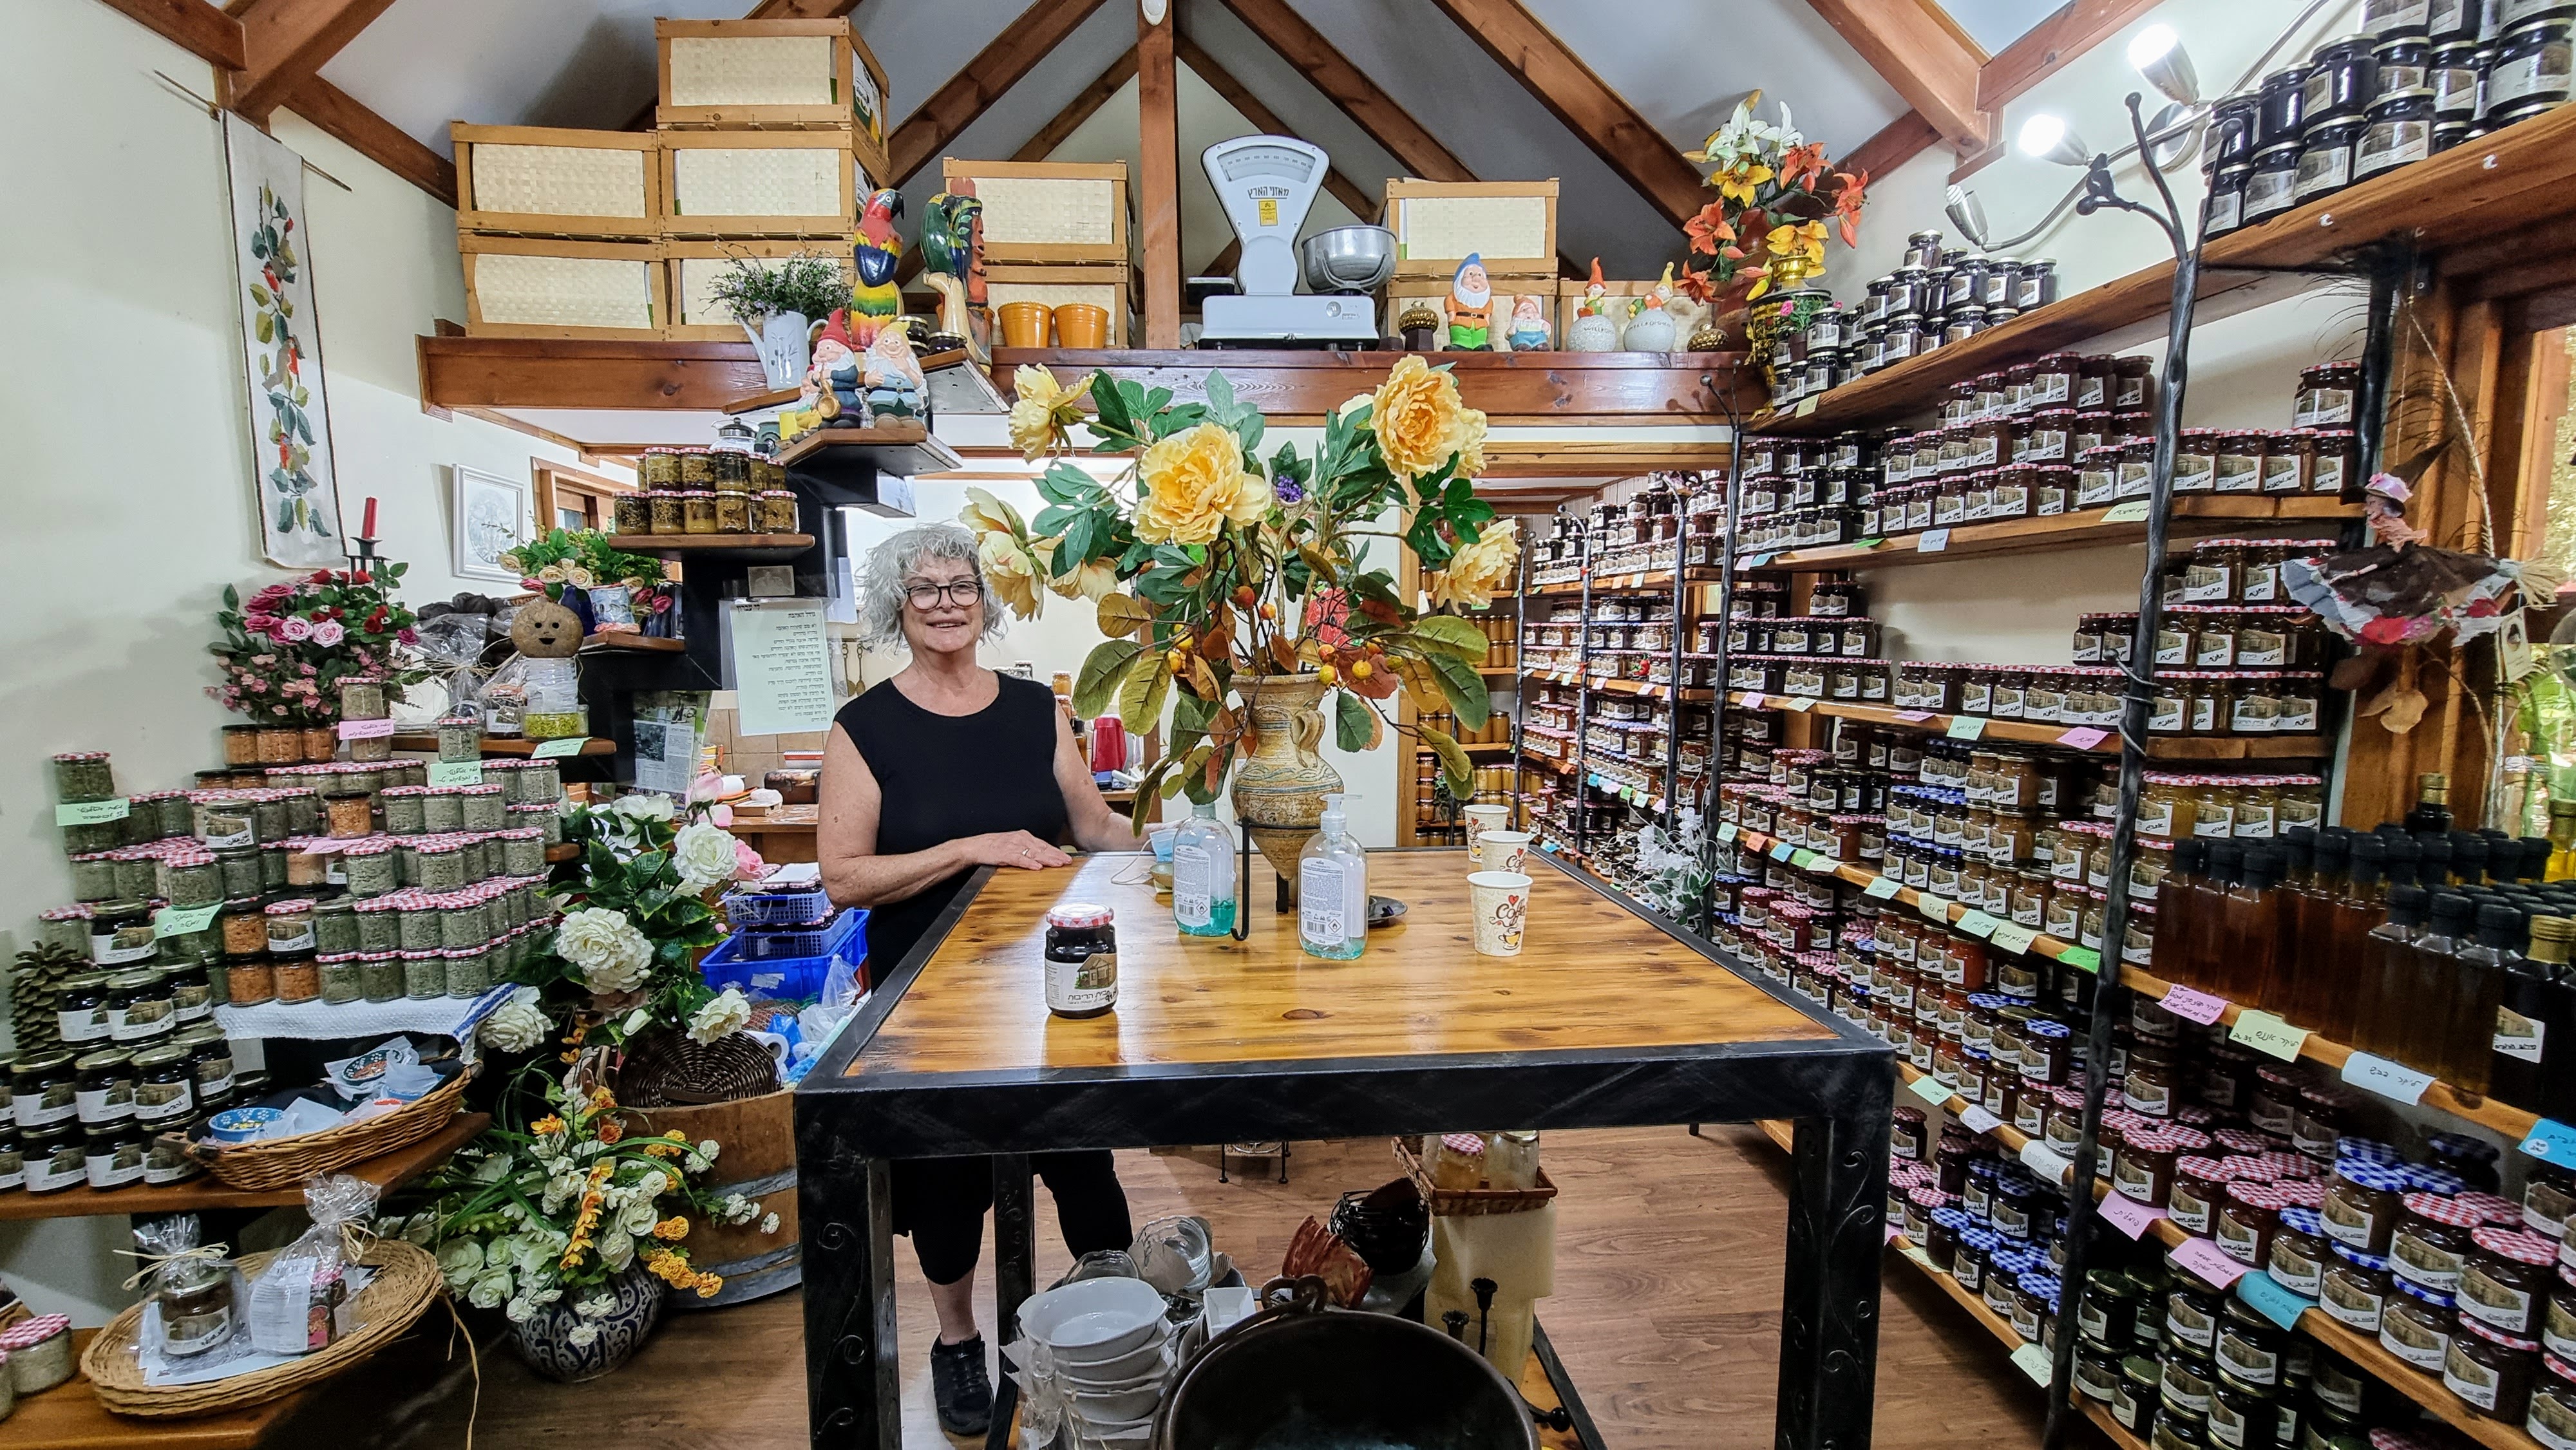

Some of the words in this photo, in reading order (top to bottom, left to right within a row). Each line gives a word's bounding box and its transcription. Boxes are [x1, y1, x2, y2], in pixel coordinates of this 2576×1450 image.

[1247, 186, 1268, 198] הארץ
[1269, 186, 1289, 196] מאזני
[1095, 990, 1108, 999] בית
[2255, 1030, 2277, 1042] אננס
[2280, 1036, 2300, 1047] ליקר
[2397, 1077, 2423, 1087] ליקר
